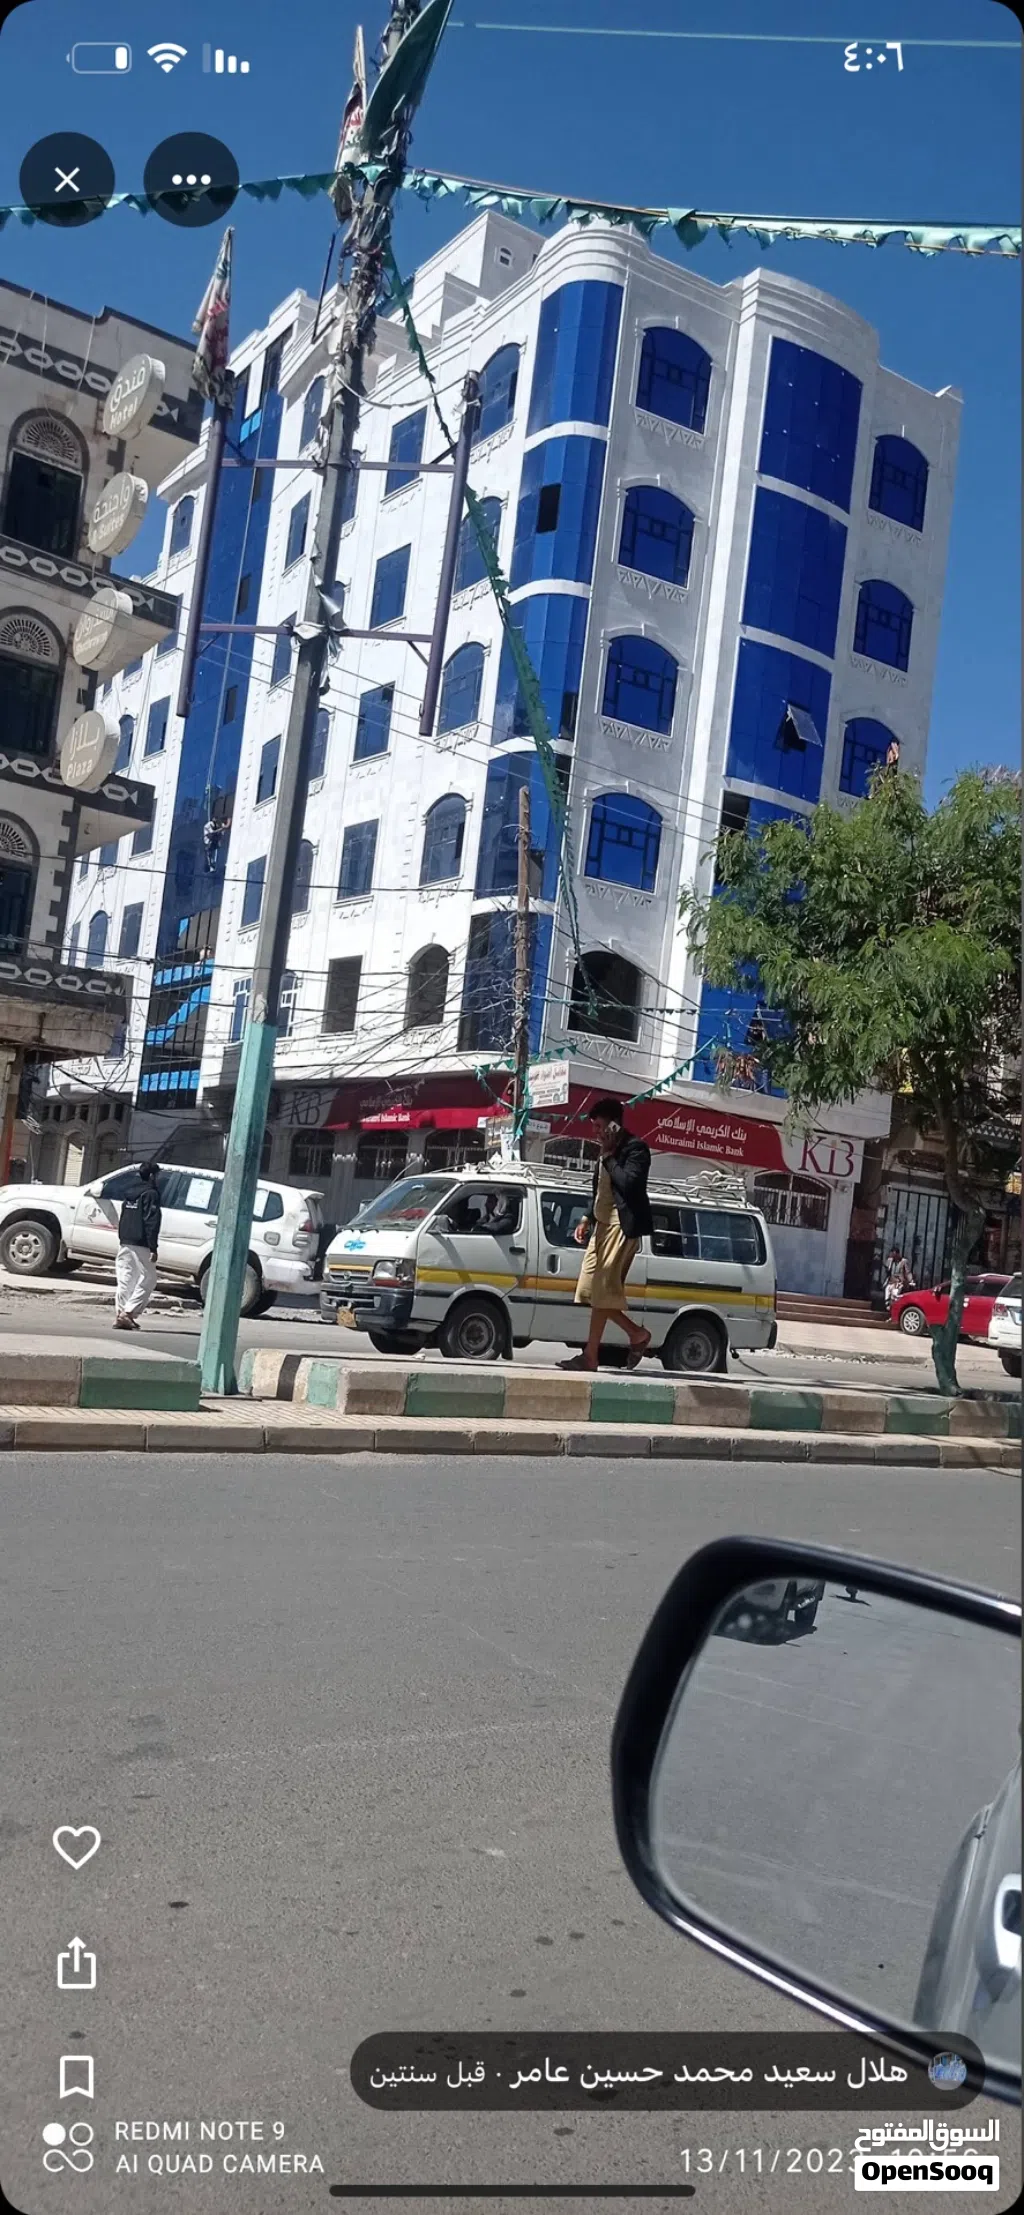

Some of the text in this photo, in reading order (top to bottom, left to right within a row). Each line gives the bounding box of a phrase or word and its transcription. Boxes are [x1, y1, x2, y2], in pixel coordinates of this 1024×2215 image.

[110, 359, 146, 413] فندق
[109, 396, 138, 430] Hotel
[69, 721, 100, 761] بلازا
[66, 760, 93, 781] Plaza
[655, 1133, 744, 1157] AlKuraimi Islamic Bank
[657, 1116, 747, 1144] بنك الكريمي الإسلامي
